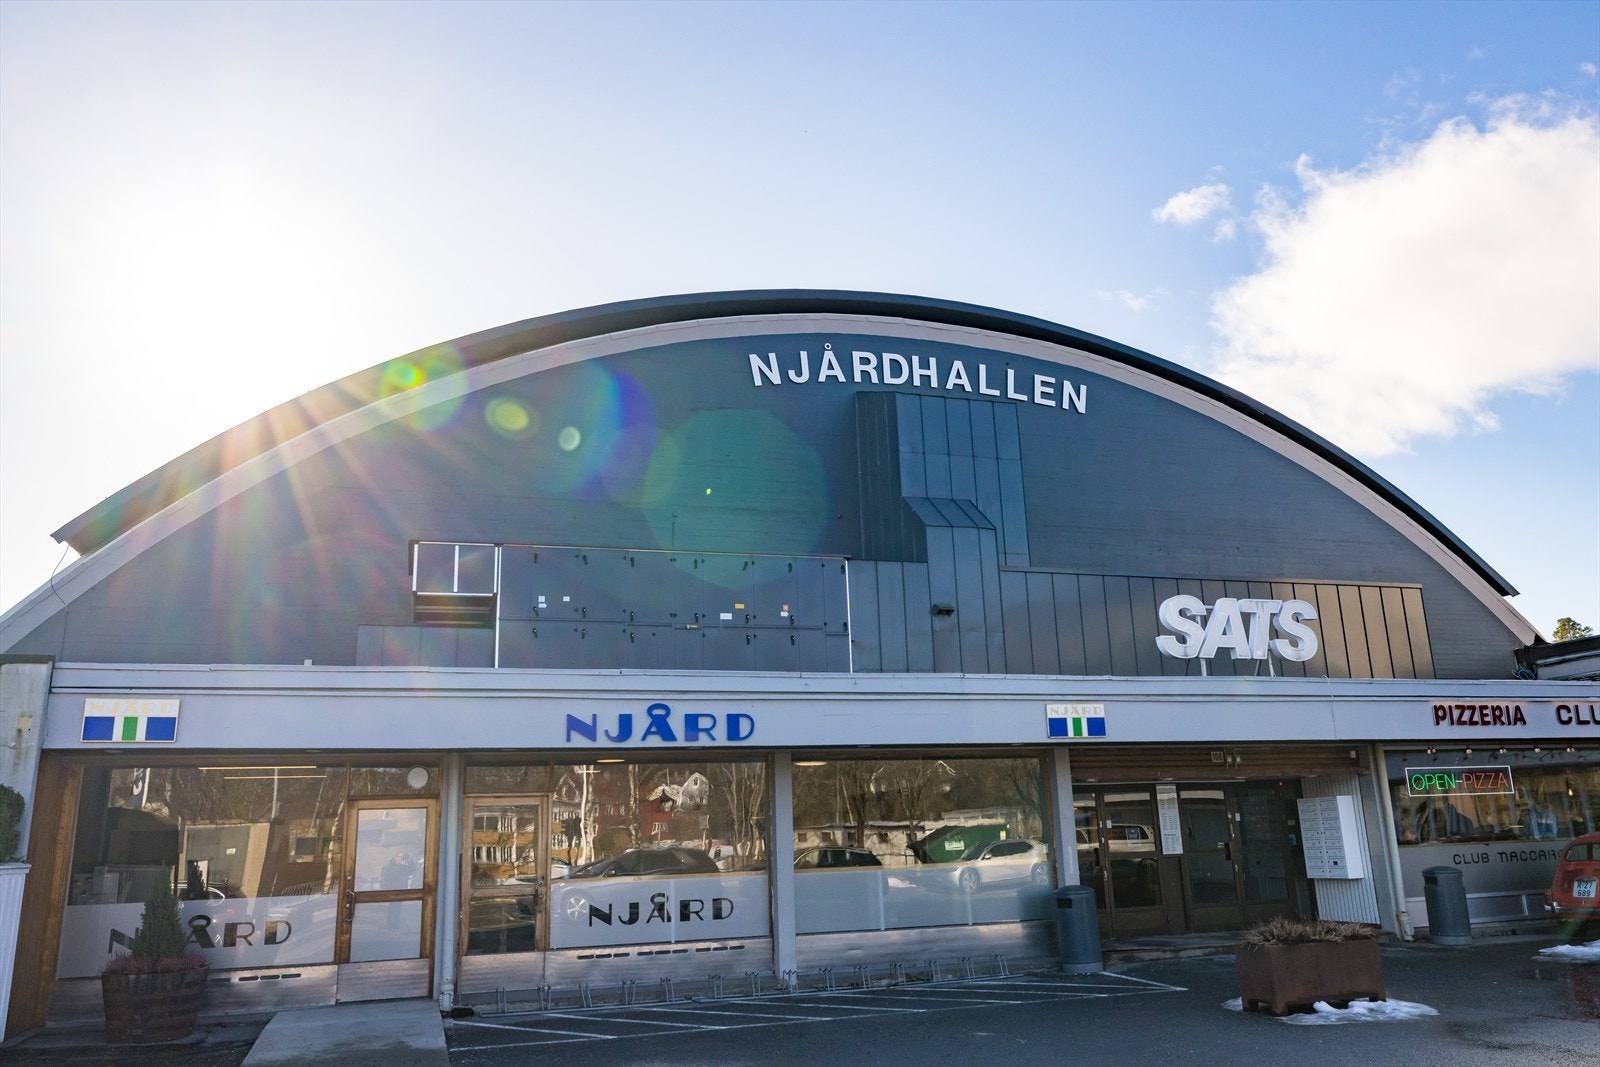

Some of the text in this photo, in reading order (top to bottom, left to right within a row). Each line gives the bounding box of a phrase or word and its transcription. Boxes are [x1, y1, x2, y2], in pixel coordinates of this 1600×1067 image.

[749, 343, 1087, 414] NJÅRDHALLEN
[1156, 595, 1318, 661] SATS
[91, 699, 173, 715] NJÅRD
[1050, 704, 1102, 716] NJÅRD
[1432, 704, 1527, 726] PIZZERIA
[566, 703, 755, 743] NJÅRD
[1452, 853, 1490, 865] CLUB
[1577, 889, 1591, 897] 689
[588, 892, 734, 927] NJÅRD
[108, 914, 292, 954] NÅRD
